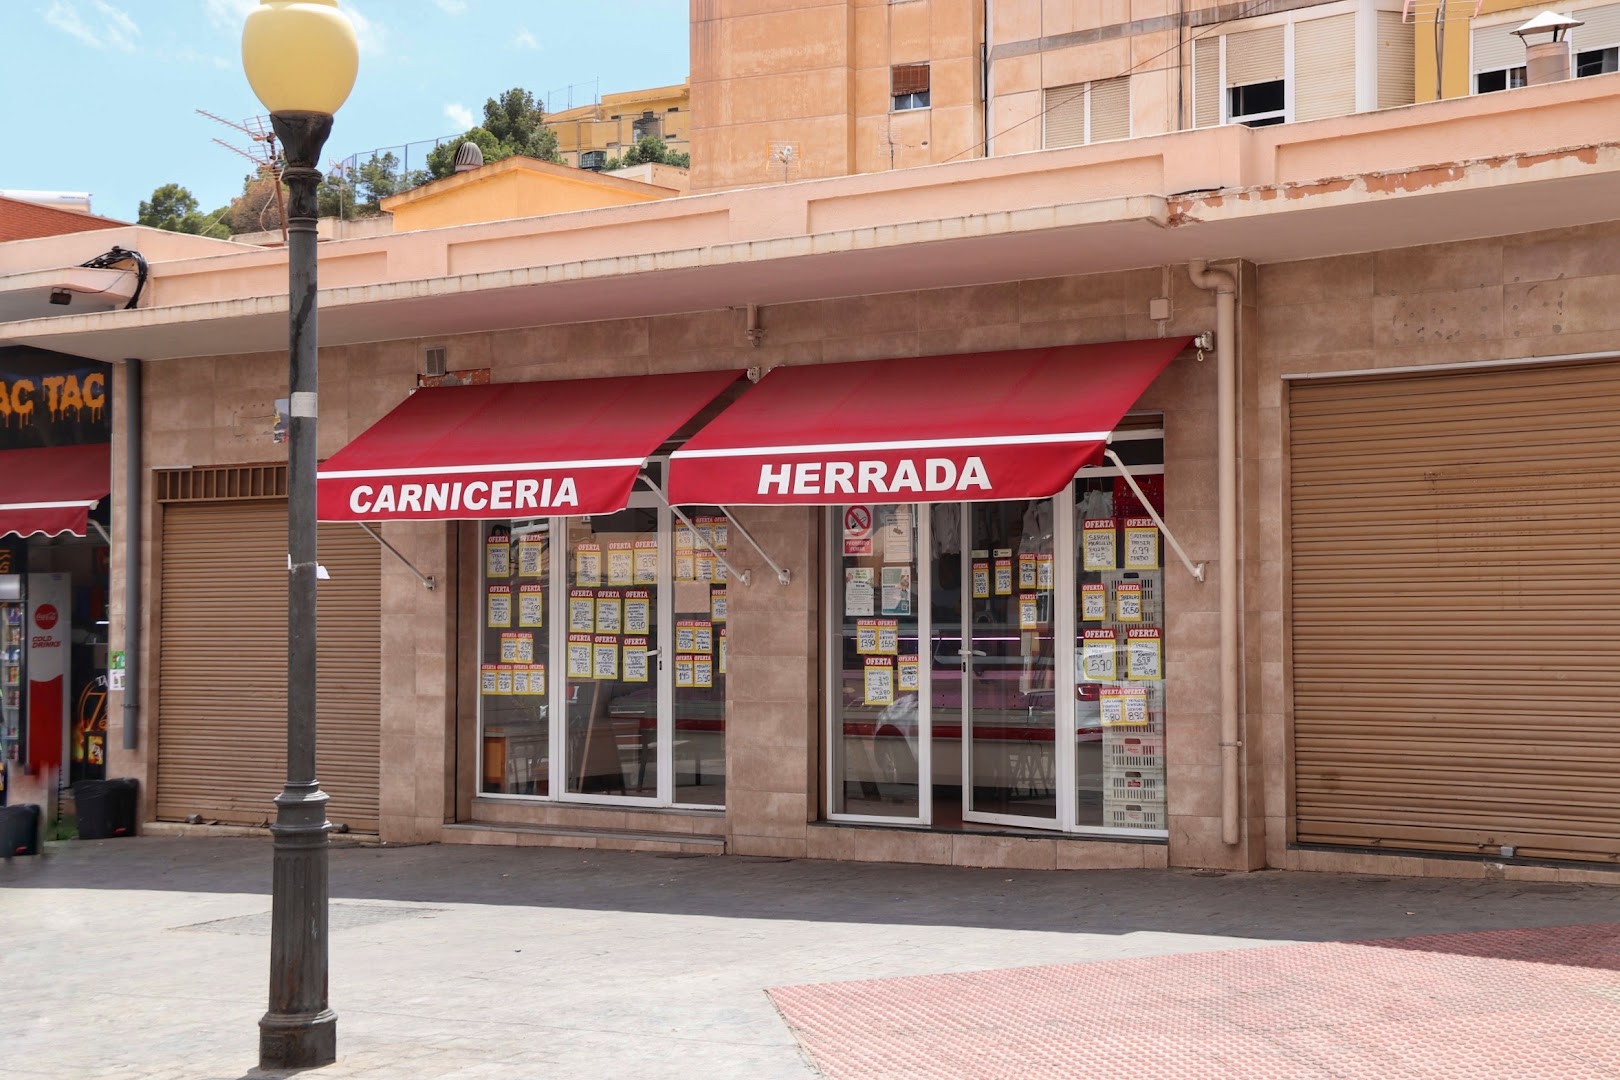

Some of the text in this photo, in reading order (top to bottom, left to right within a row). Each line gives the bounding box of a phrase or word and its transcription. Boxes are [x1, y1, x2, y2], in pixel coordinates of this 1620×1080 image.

[42, 372, 105, 419] TAC
[757, 456, 993, 495] HERRADA
[349, 477, 579, 513] CARNICERIA
[1085, 520, 1115, 529] OFERTA
[1126, 518, 1156, 527] OFERTA
[520, 534, 541, 542] OFERTA
[609, 542, 631, 550] OFERTA
[635, 540, 657, 548] OFERTA
[1084, 630, 1115, 638] OFERTA
[1128, 629, 1159, 637] OFERTA
[569, 634, 591, 642] OFERTA
[865, 657, 892, 665] OFERTA
